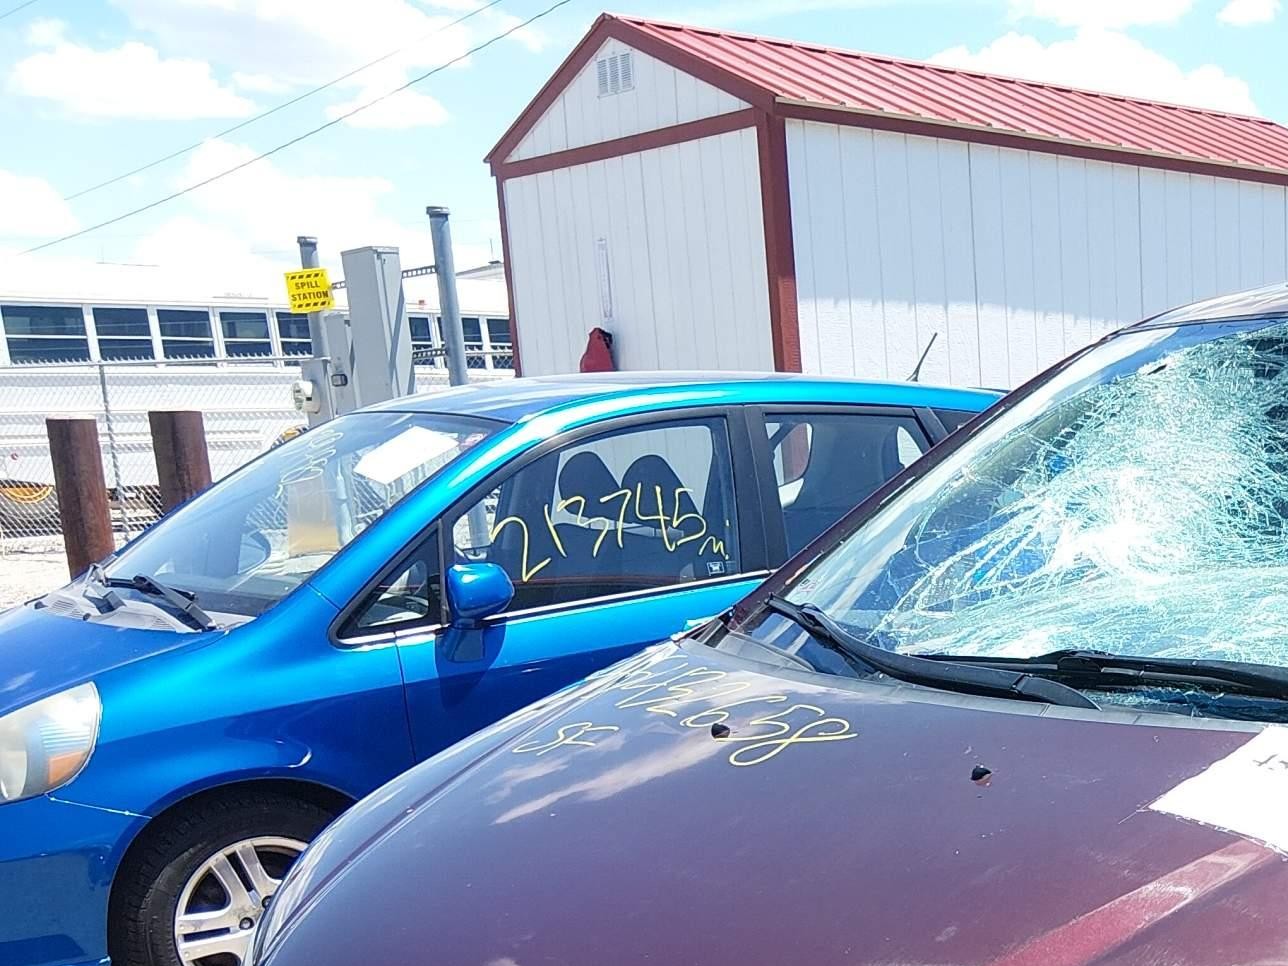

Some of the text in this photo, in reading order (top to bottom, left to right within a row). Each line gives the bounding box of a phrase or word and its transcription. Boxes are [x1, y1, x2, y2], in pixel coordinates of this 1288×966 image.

[295, 281, 320, 290] SPILL
[291, 290, 329, 302] STATION
[489, 482, 707, 582] 213745
